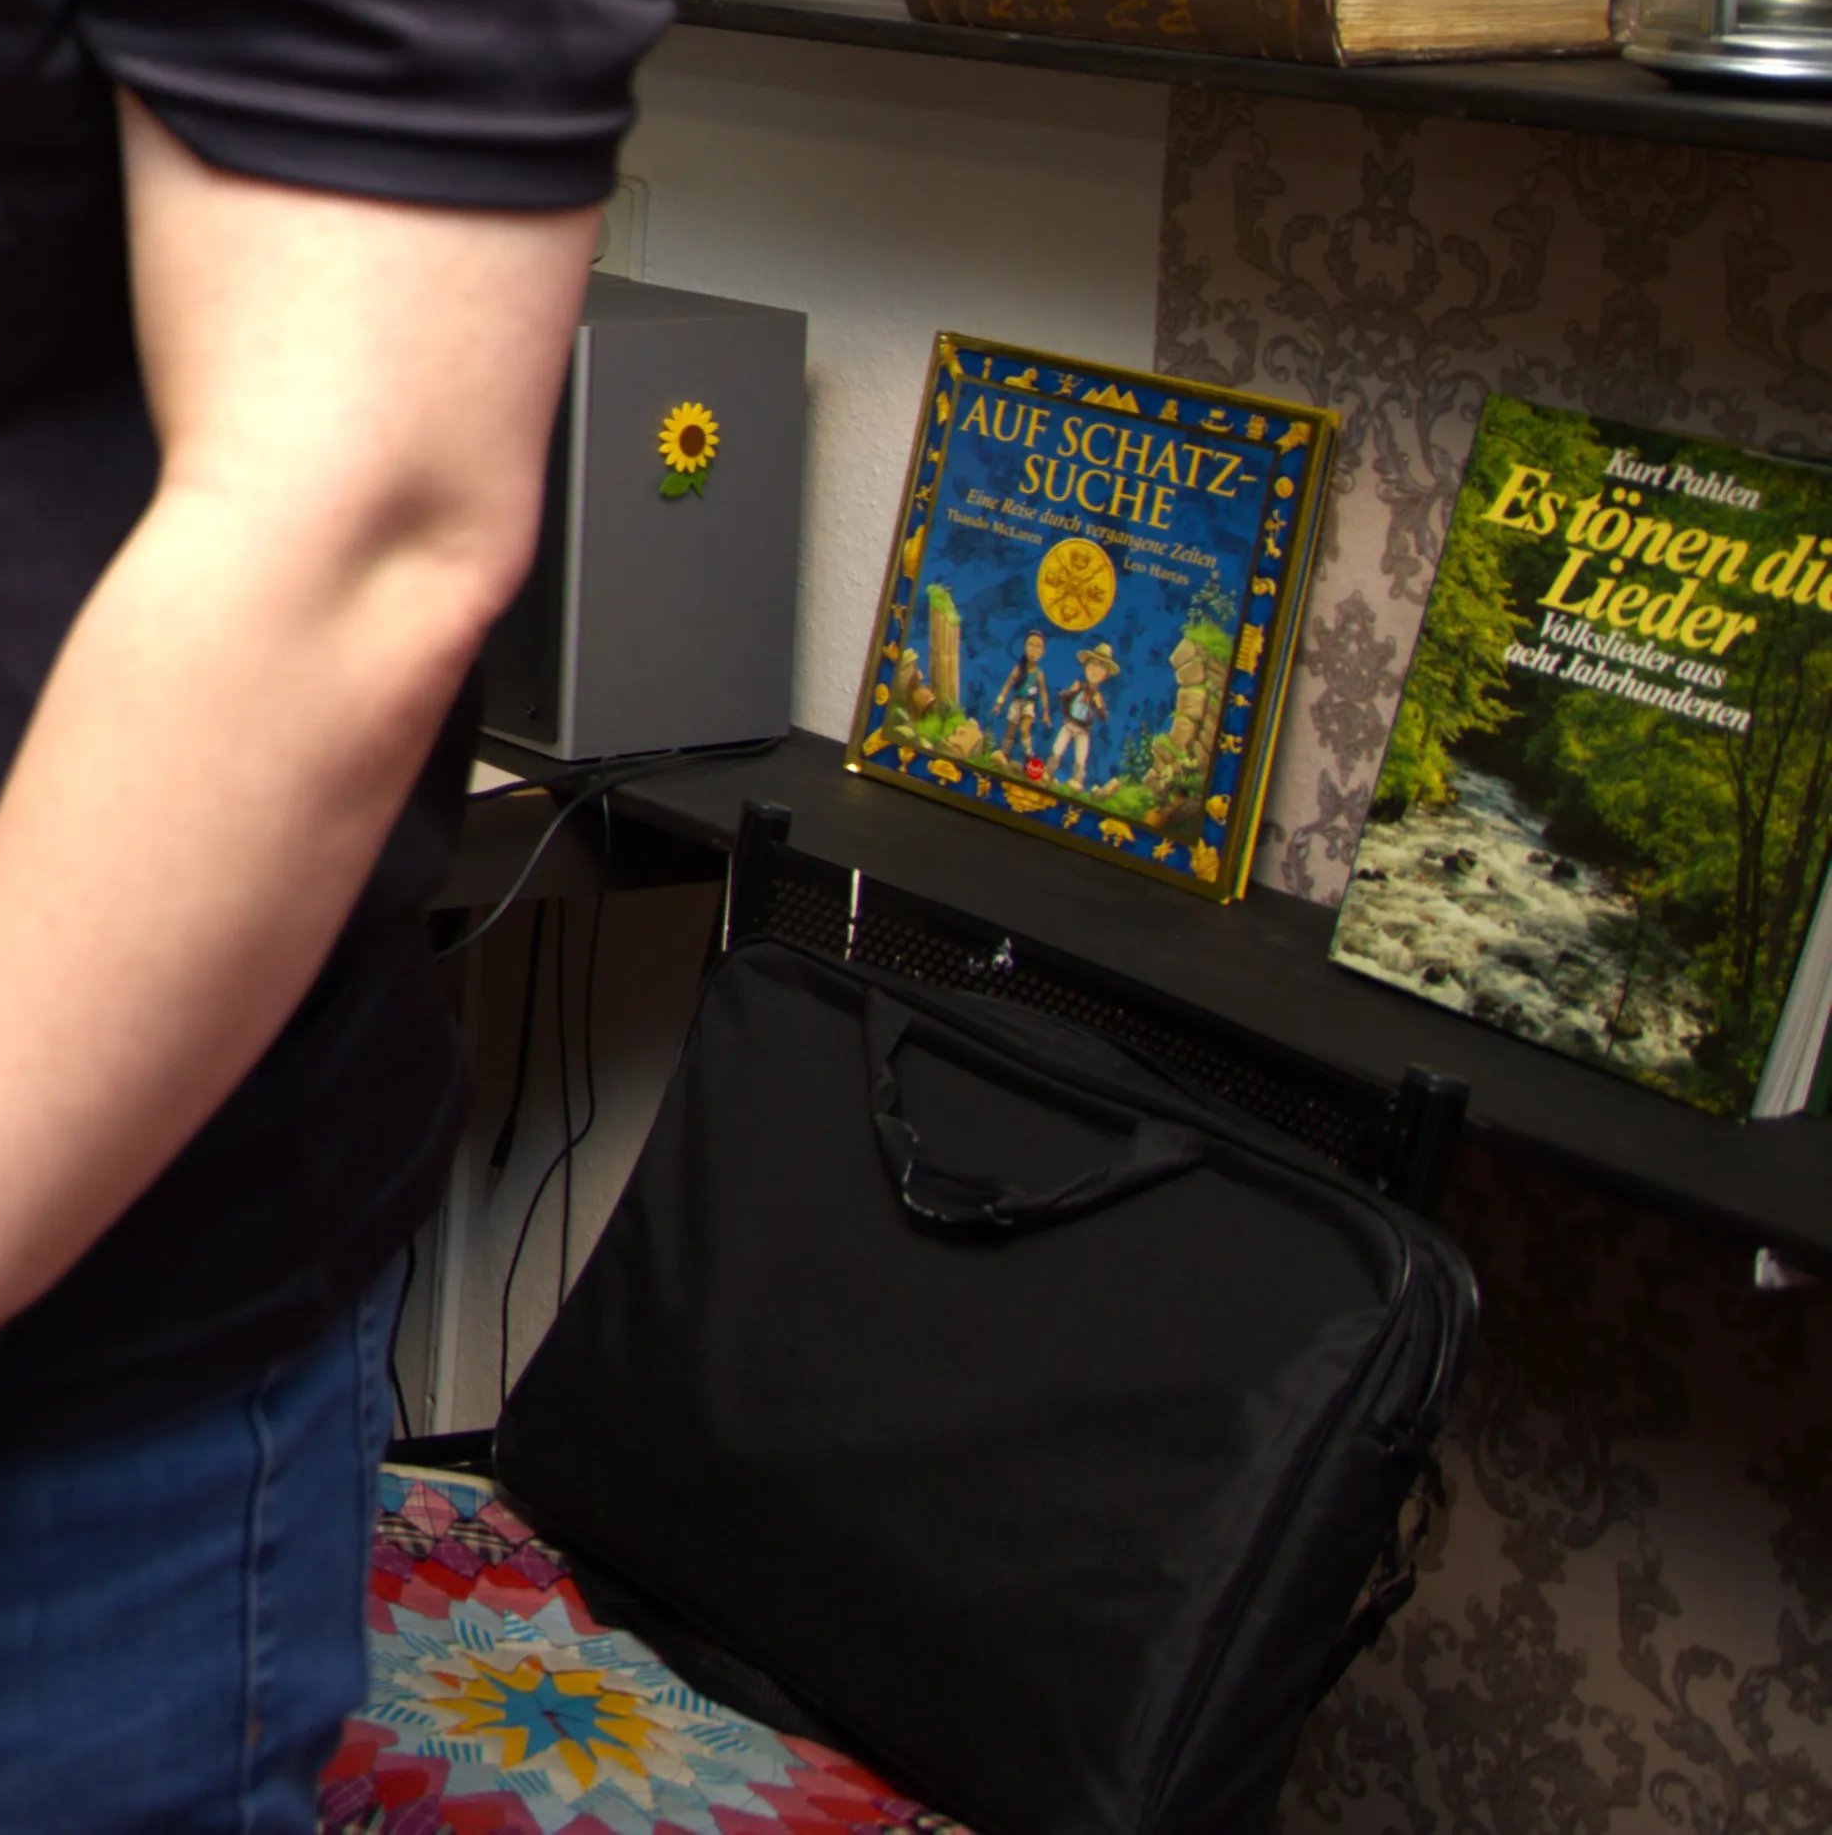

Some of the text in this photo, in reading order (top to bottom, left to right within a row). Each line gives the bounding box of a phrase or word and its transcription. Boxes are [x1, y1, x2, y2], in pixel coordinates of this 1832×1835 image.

[960, 394, 1258, 500] AUF SCHATZ-
[1605, 447, 1763, 510] Kurt Pahlen
[965, 488, 1218, 569] Eine Reise durch vergangene Zeiten
[1018, 453, 1177, 532] SUCHE
[1482, 463, 1567, 537] Es
[1565, 488, 1747, 587] tönen
[1123, 555, 1147, 574] Leo
[1538, 547, 1758, 658] Lieder
[1502, 640, 1753, 734] acht Jahrhunderten
[1539, 611, 1728, 690] Volkslieder aus
